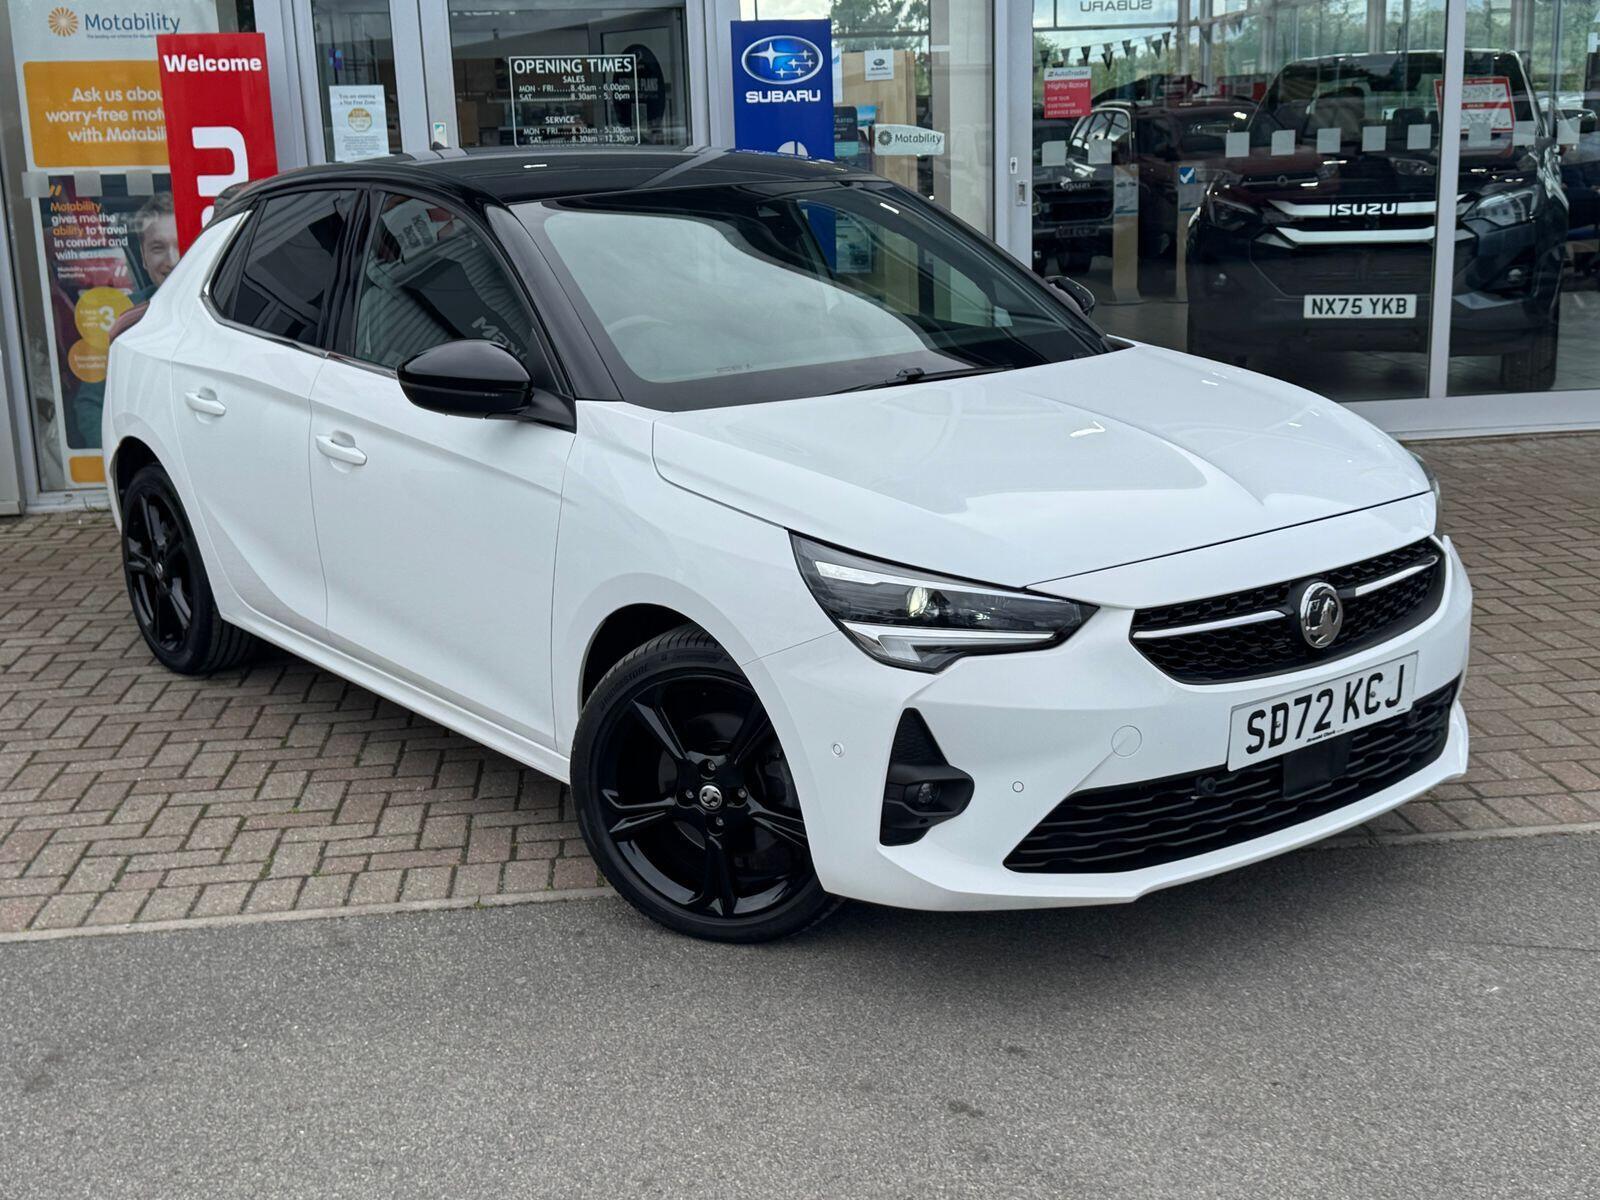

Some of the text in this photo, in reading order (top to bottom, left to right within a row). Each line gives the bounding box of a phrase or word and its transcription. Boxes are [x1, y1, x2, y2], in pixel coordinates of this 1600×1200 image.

[84, 12, 180, 34] Motability
[163, 54, 262, 72] Welcome
[514, 58, 632, 74] OPENING TIMES
[562, 75, 585, 83] SALES
[72, 86, 163, 102] Ask us abou
[519, 85, 536, 93] MON
[603, 92, 630, 101] 5.0pm
[746, 90, 821, 103] SUBARU
[45, 106, 166, 125] worry-free mot
[545, 116, 575, 124] SERVICE
[68, 126, 168, 143] with Motabili
[895, 134, 942, 144] Motability
[50, 201, 102, 212] Motability
[1331, 203, 1397, 215] ISUZU
[51, 214, 77, 226] gives
[53, 224, 128, 236] ability to travel
[54, 237, 128, 247] in comfort and
[55, 250, 78, 259] with
[1311, 297, 1407, 315] NX75 YKB
[99, 305, 116, 332] 3
[1246, 664, 1405, 755] SD72 KCJ
